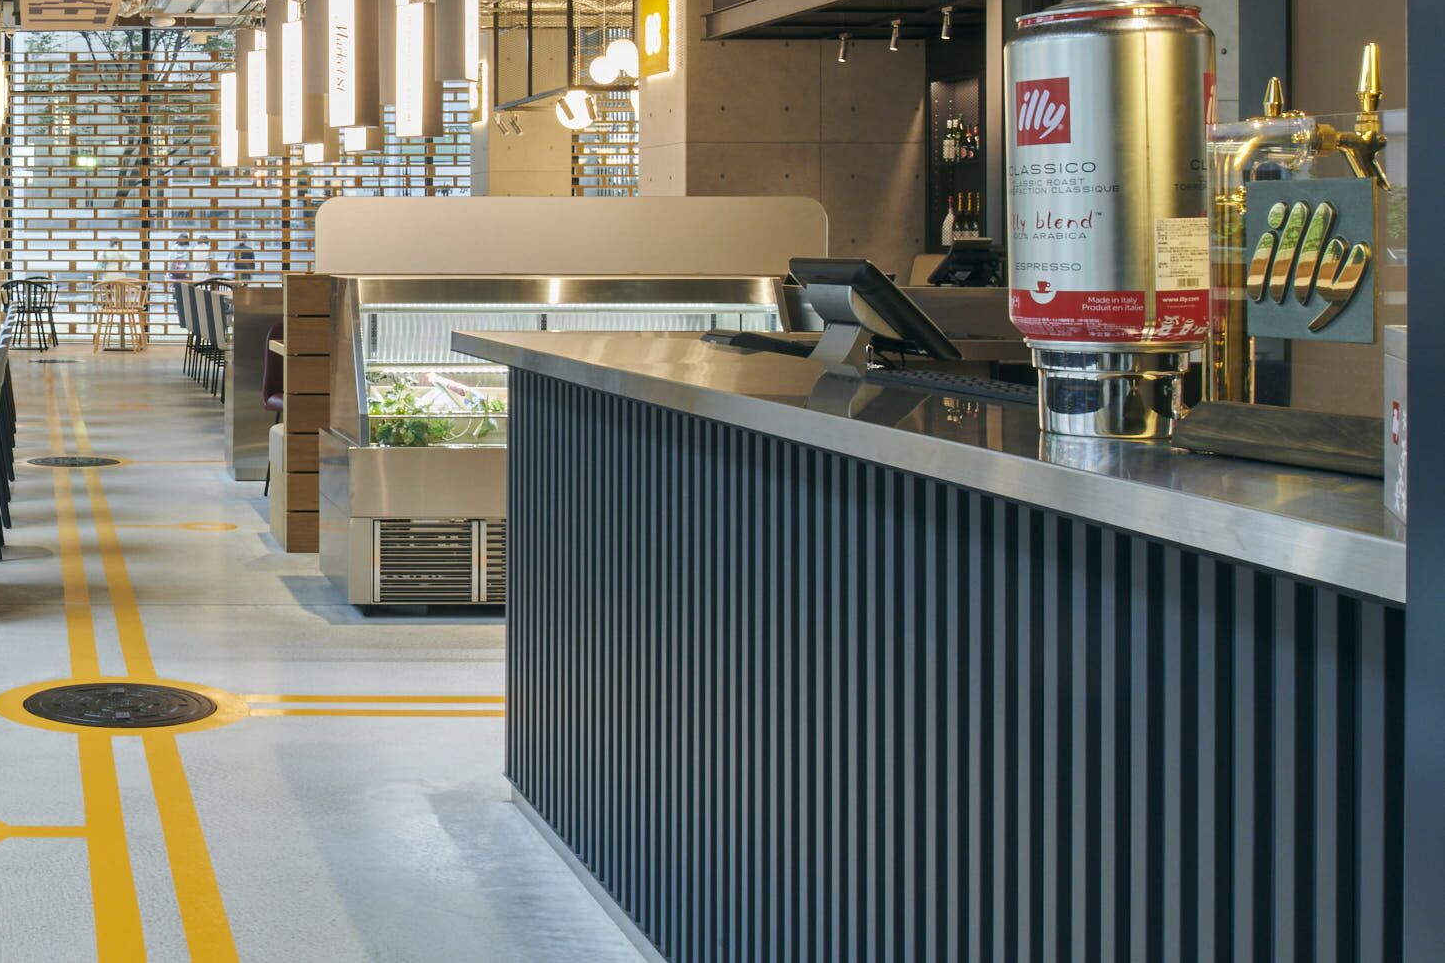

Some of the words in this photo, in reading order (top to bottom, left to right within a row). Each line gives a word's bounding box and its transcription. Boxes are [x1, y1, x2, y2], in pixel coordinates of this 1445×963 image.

[333, 22, 348, 76] Market
[1018, 88, 1066, 139] illy
[1046, 178, 1086, 186] ROAST
[1050, 184, 1121, 194] CLASSIQUE
[1032, 231, 1087, 240] ARABICA
[1015, 262, 1082, 272] ESPRESSO
[1246, 200, 1372, 332] illy
[1087, 295, 1110, 304] Made
[1111, 296, 1120, 304] in
[1121, 295, 1138, 305] Italy
[1082, 303, 1111, 312] Produit
[1124, 303, 1144, 312] Italie
